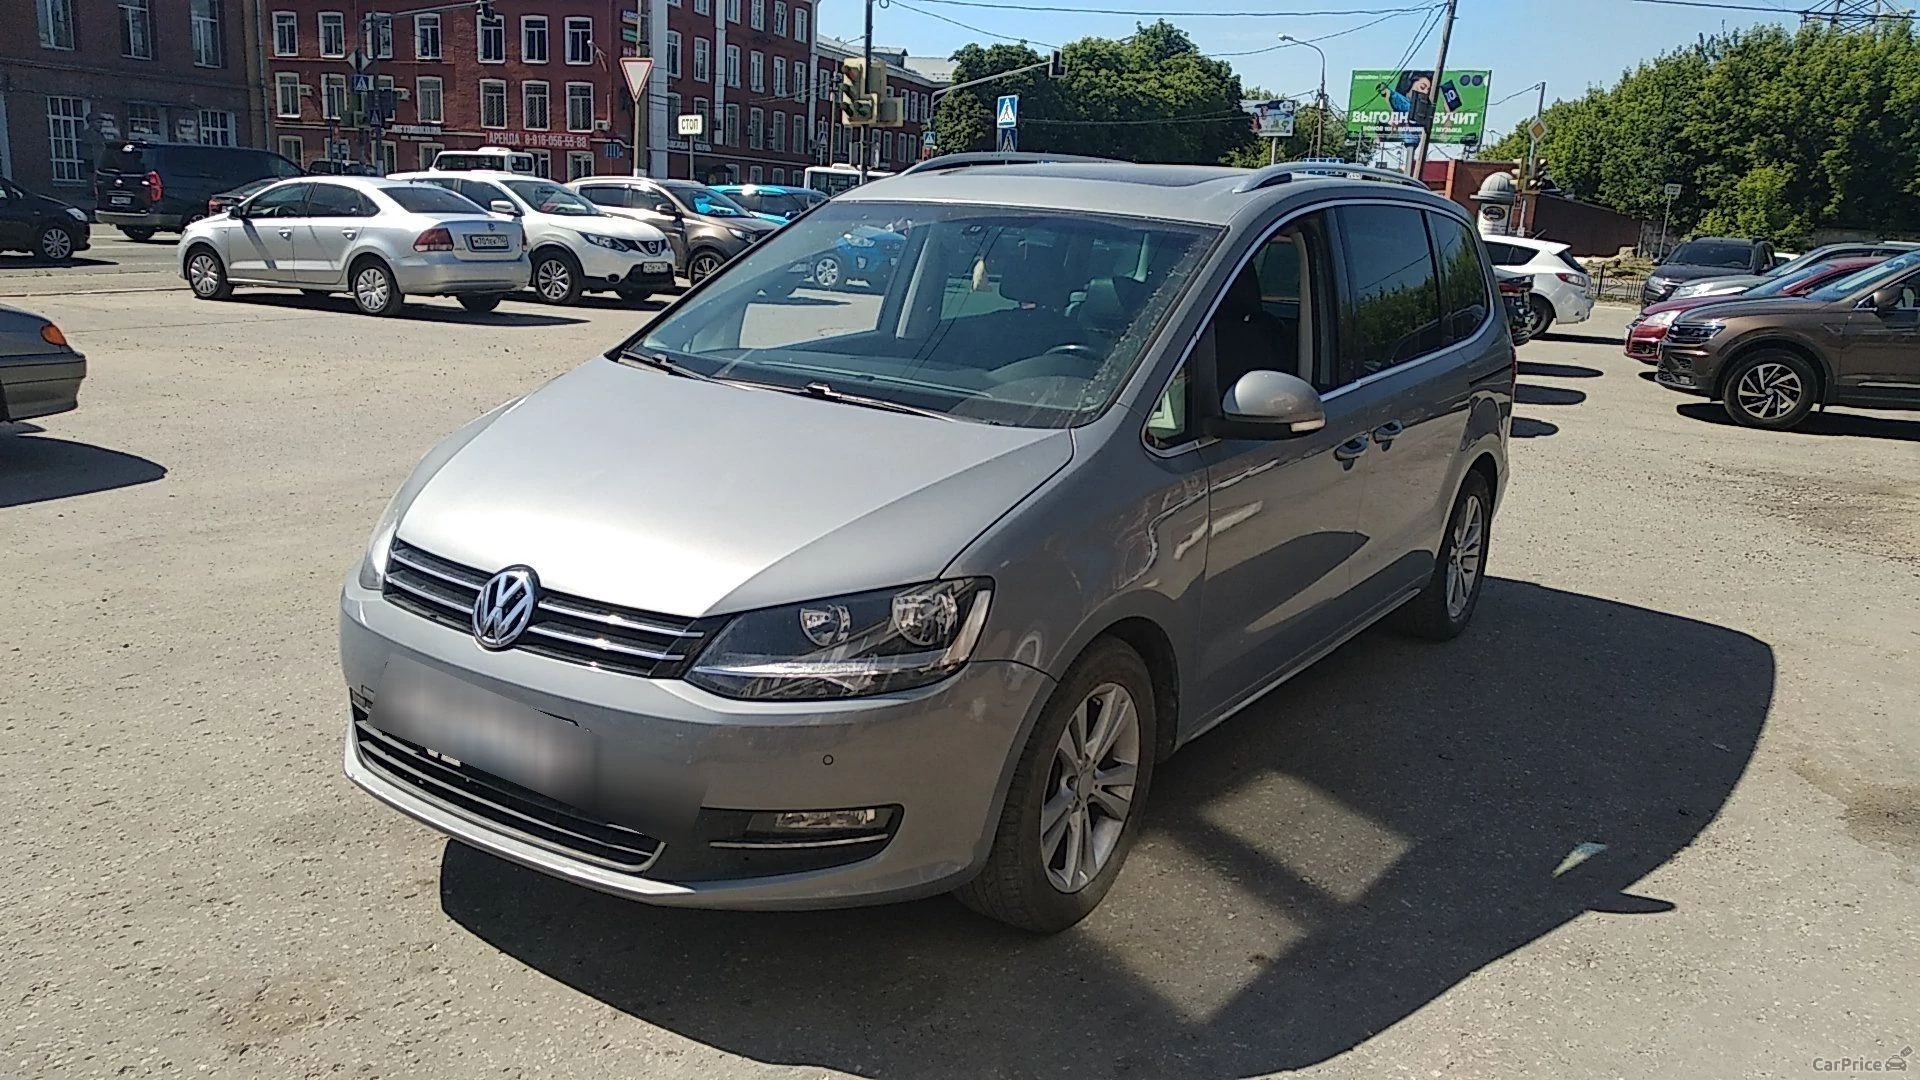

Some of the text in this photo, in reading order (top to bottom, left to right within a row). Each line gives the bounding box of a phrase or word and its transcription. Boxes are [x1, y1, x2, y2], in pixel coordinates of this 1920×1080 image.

[681, 118, 699, 130] СТОП
[1352, 111, 1478, 125] ВЫГОДН ВУЧИТ
[488, 131, 520, 146] АРЕНДА
